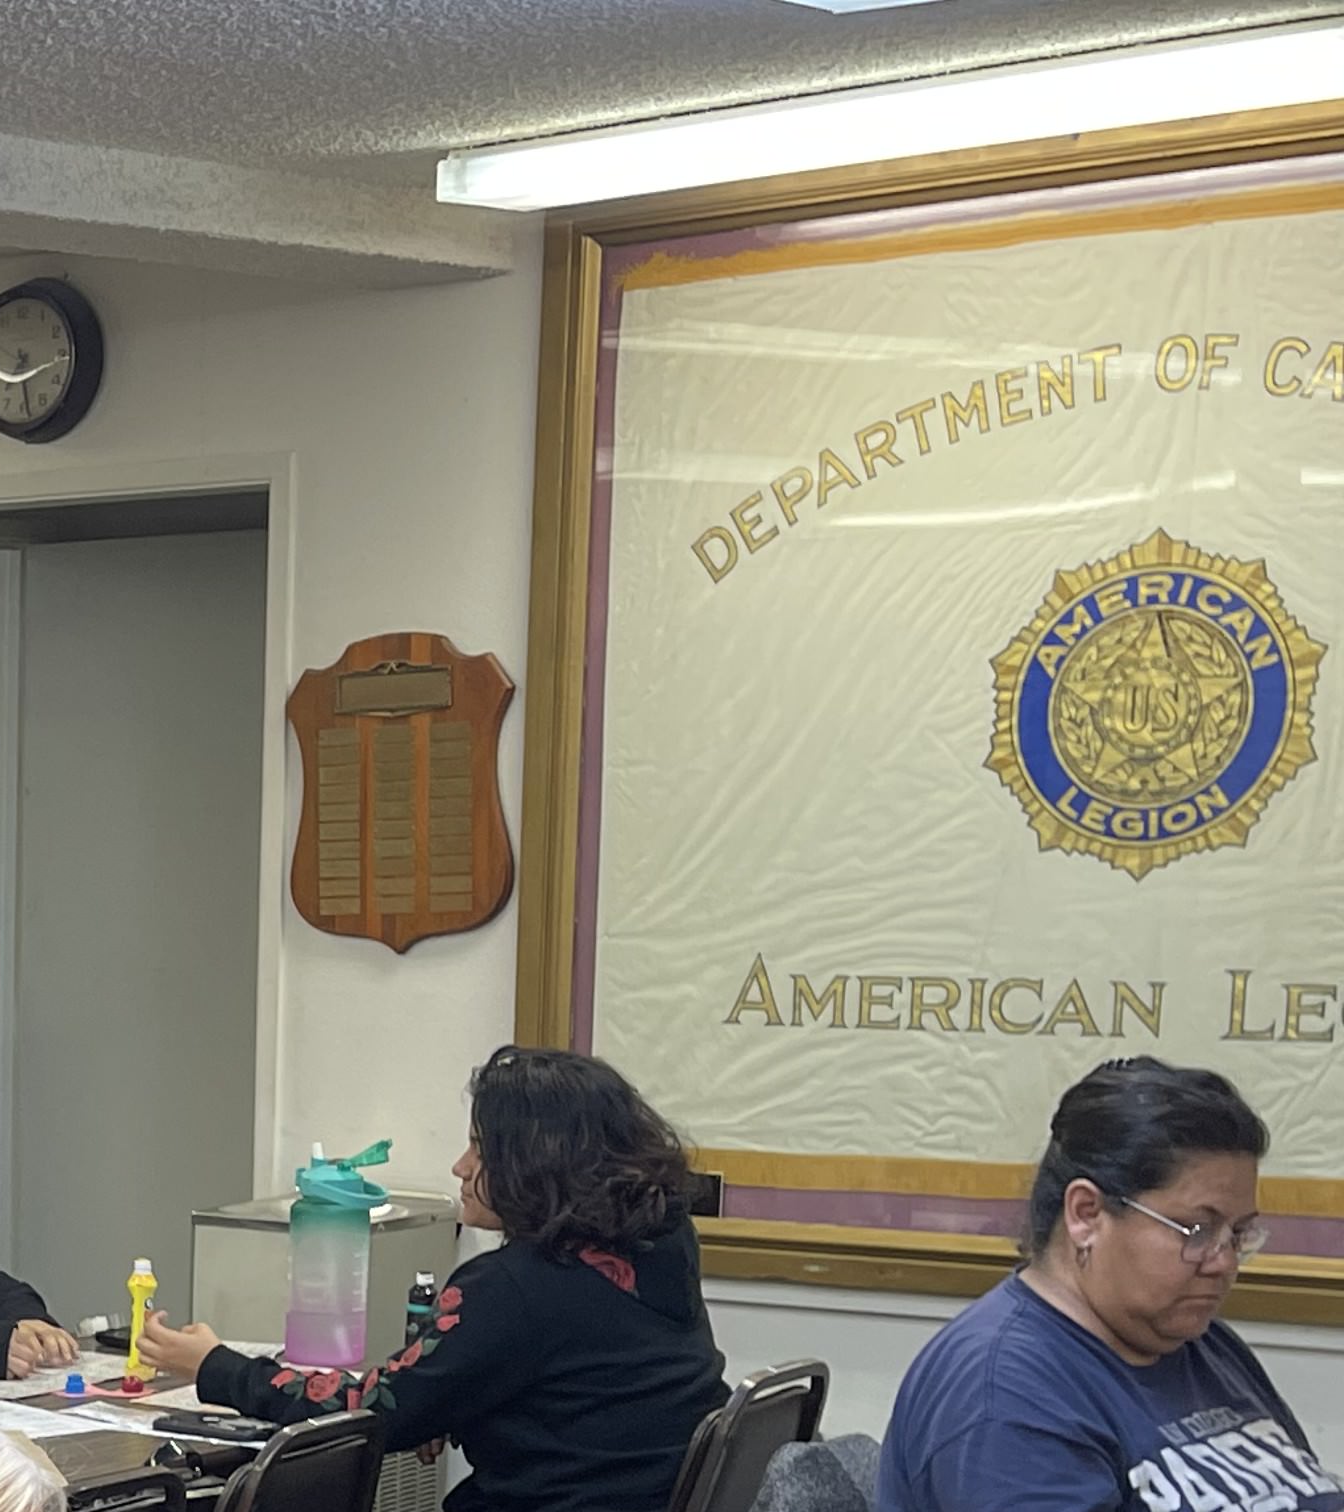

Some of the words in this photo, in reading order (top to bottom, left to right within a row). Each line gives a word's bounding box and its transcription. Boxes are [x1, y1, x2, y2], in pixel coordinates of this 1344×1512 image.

[691, 345, 1123, 584] DEPARTMENT
[1155, 334, 1240, 391] OF
[1033, 574, 1281, 680] AMERICAN
[1055, 782, 1231, 840] LEGION
[723, 953, 1167, 1038] AMERICAN
[1219, 968, 1344, 1043] LE
